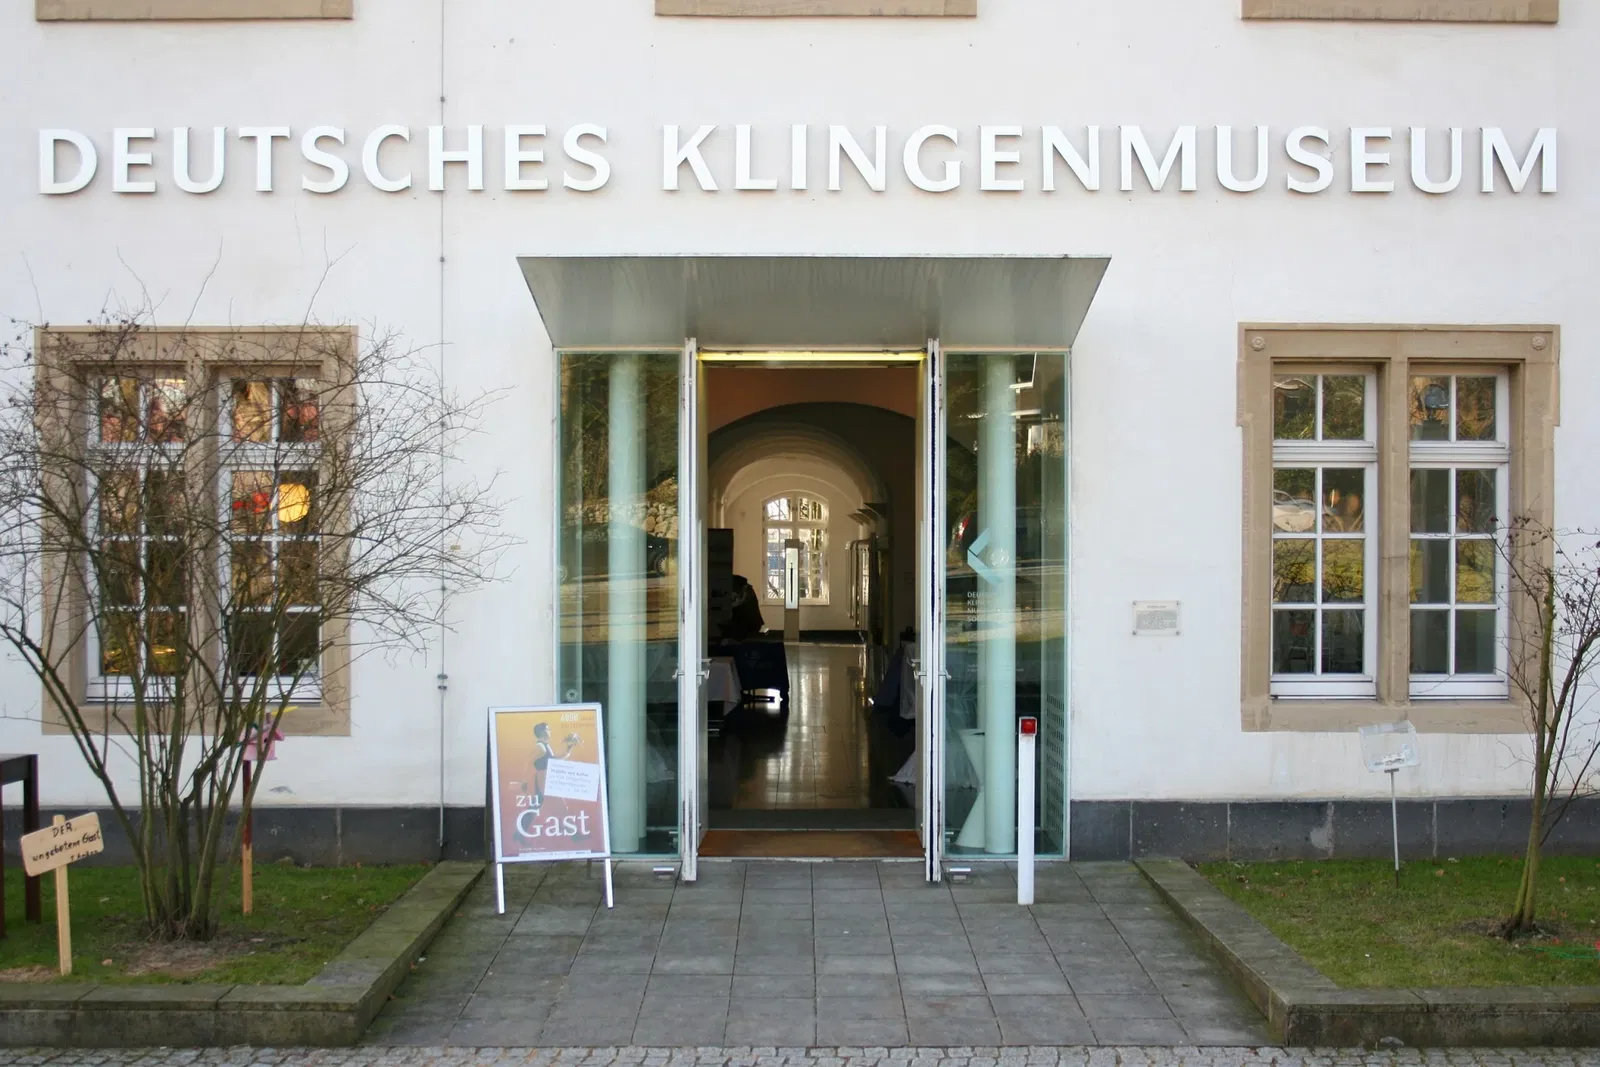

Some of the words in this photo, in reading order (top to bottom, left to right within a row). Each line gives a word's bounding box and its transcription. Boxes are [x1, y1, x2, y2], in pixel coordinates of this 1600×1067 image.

[38, 123, 612, 195] DEUTSCHES
[661, 123, 1559, 194] KLINGENMUSEUM
[516, 794, 541, 808] zu
[516, 809, 591, 838] Gast
